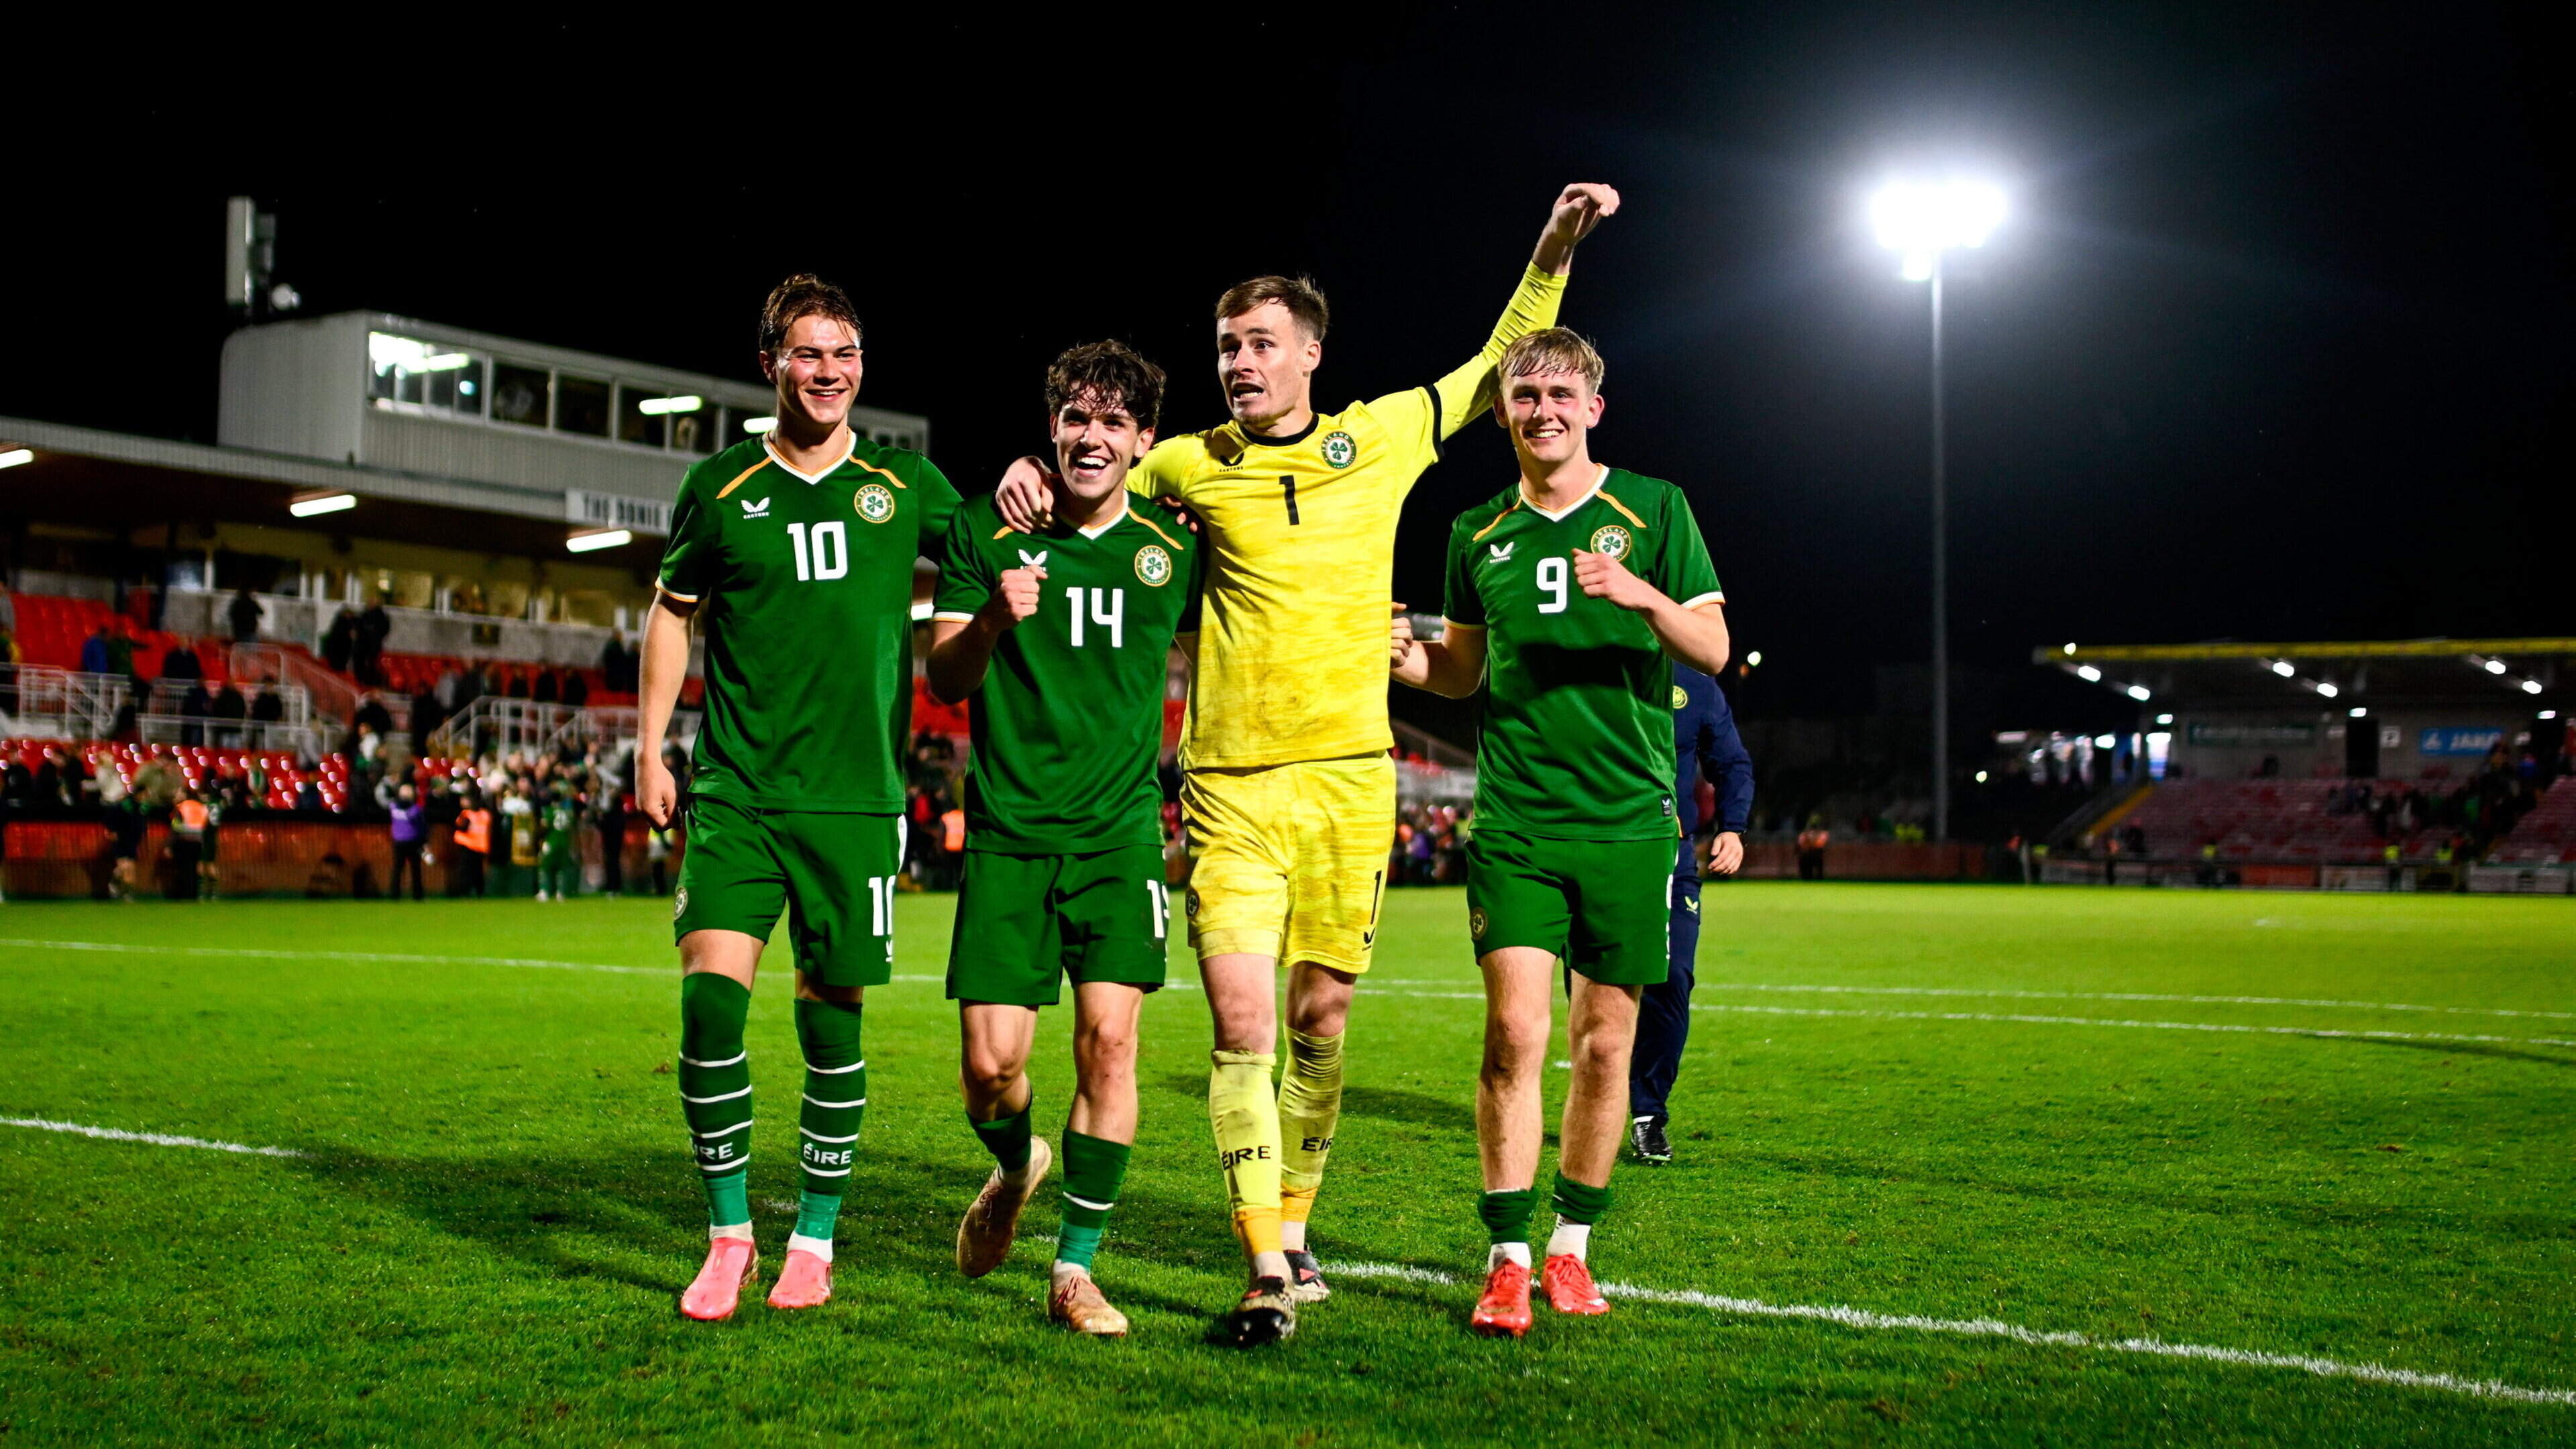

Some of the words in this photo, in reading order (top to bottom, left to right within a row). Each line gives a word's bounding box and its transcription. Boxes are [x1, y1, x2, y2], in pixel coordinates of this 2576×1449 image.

[1279, 475, 1299, 526] 1
[787, 521, 848, 582] 10
[1536, 557, 1568, 614] 9
[1066, 586, 1124, 648] 14
[693, 1142, 734, 1161] IRE
[804, 1142, 853, 1165] ÉIRE
[1221, 1145, 1271, 1171] ÉIRE
